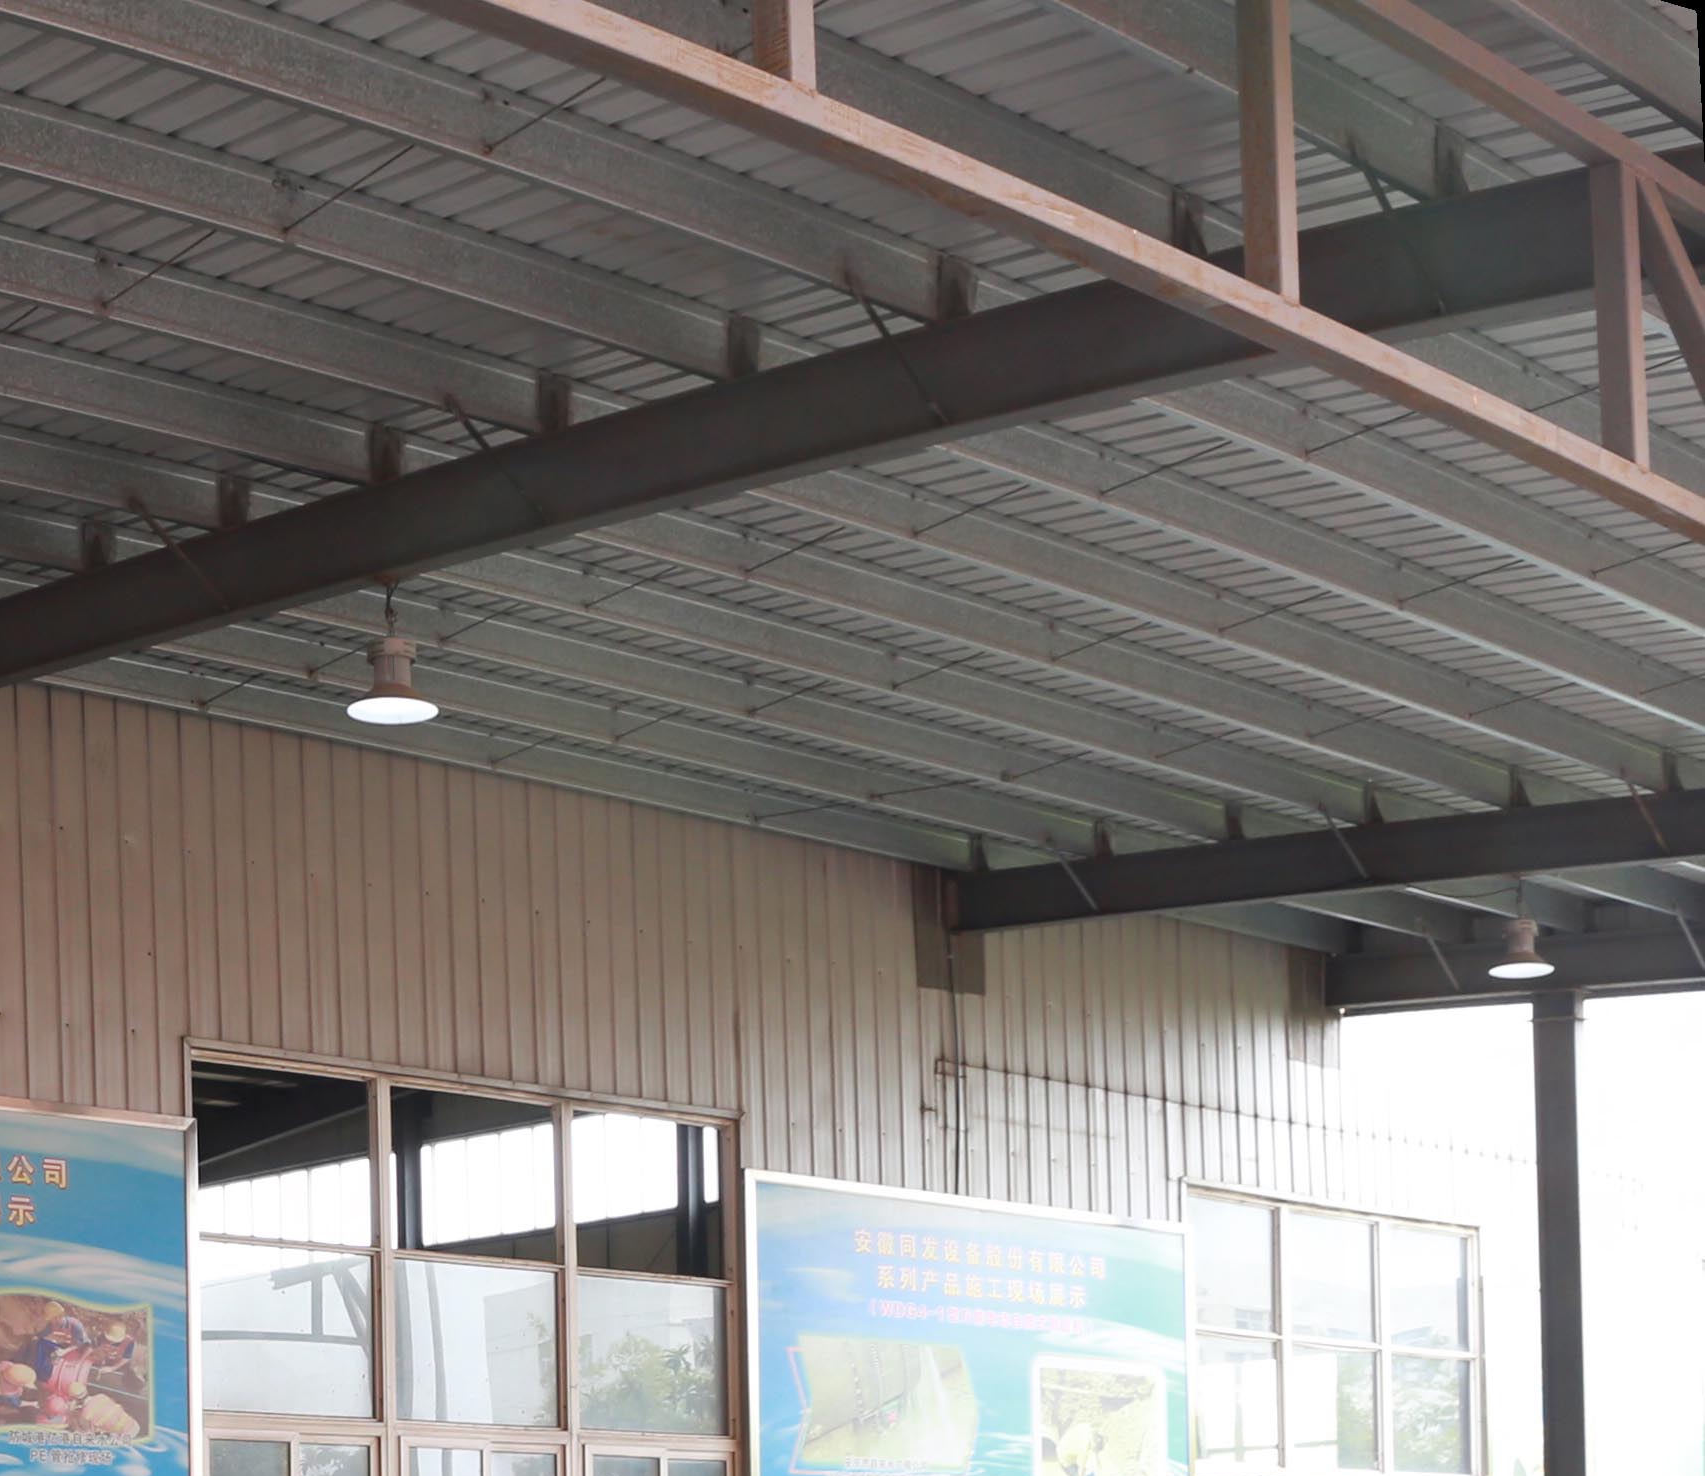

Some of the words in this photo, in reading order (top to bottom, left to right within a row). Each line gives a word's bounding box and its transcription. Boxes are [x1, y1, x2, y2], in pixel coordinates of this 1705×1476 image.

[853, 1228, 1107, 1281] 安徽同发设备股份有限公司
[877, 1264, 1087, 1310] 系列产品施工现场展示
